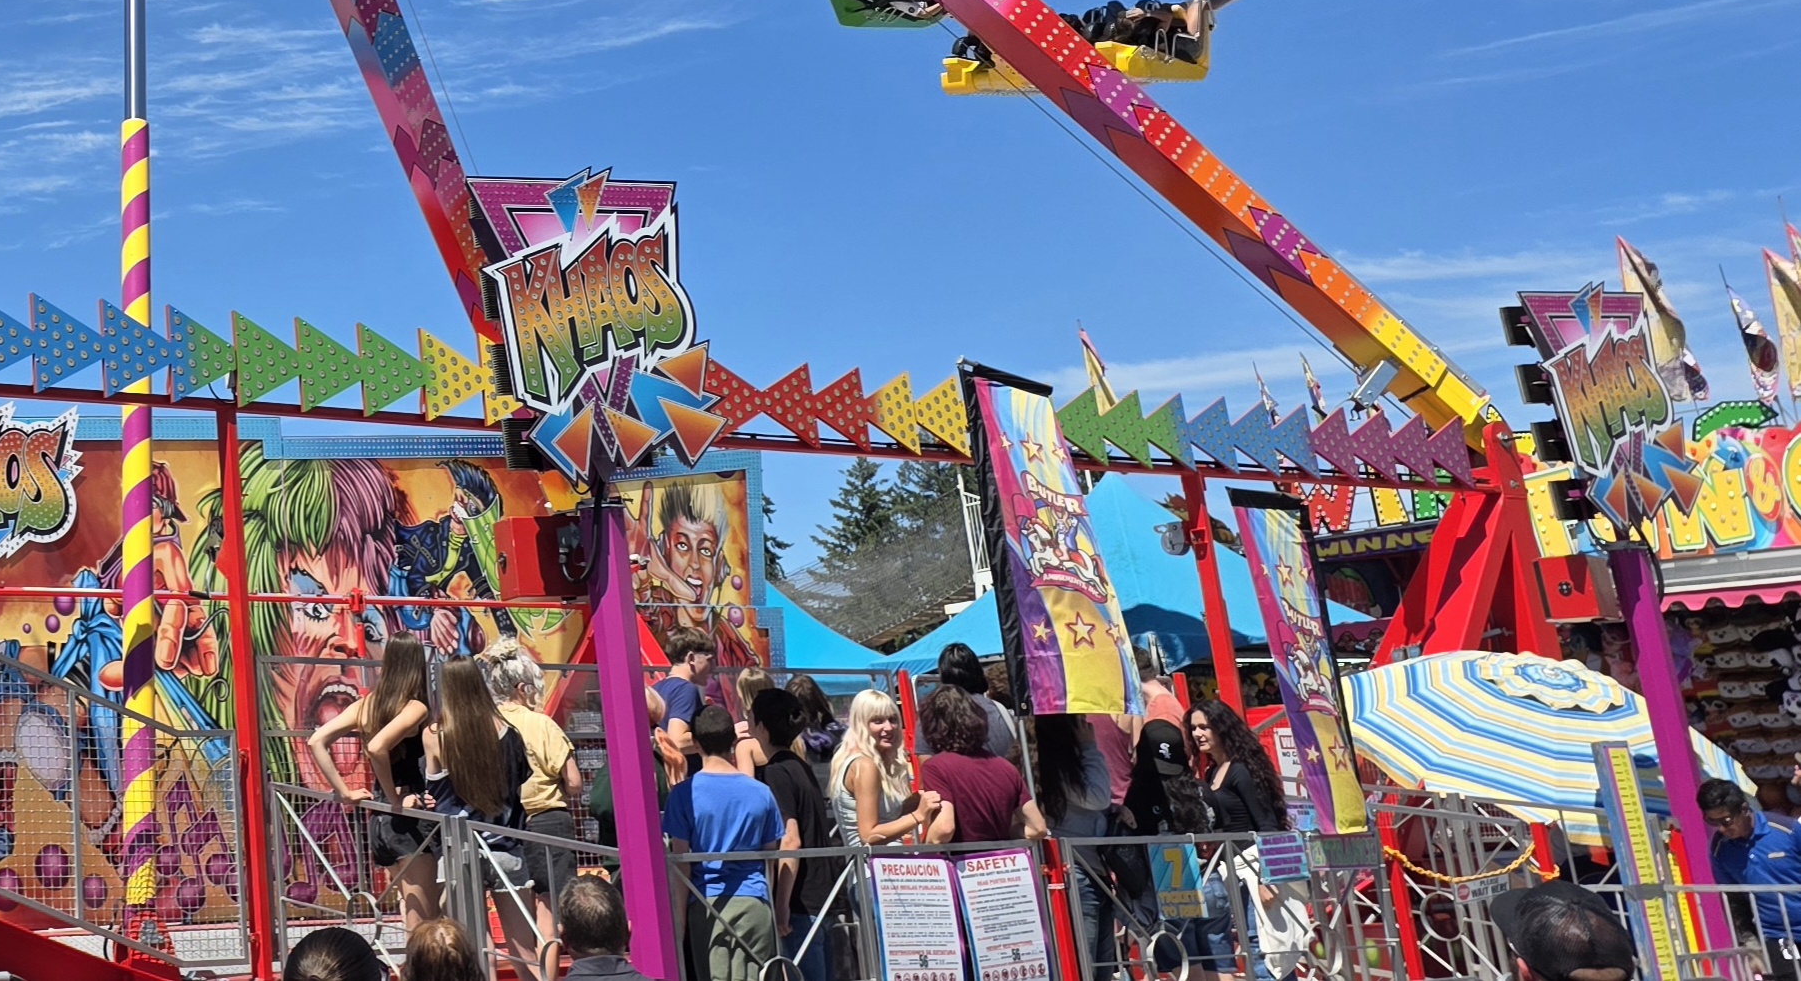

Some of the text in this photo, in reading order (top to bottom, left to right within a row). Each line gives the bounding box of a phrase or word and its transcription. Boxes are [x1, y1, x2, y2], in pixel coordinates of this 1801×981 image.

[501, 231, 685, 397] KHAOS
[1550, 331, 1666, 464] KHAOS
[1025, 472, 1082, 514] BUTLER
[881, 861, 941, 877] PRECAUCIÓN
[966, 855, 1017, 872] SAFETY
[1163, 847, 1184, 889] 7
[1158, 890, 1204, 904] TICKETS
[1471, 886, 1489, 898] WAIT
[1161, 905, 1177, 918] TO
